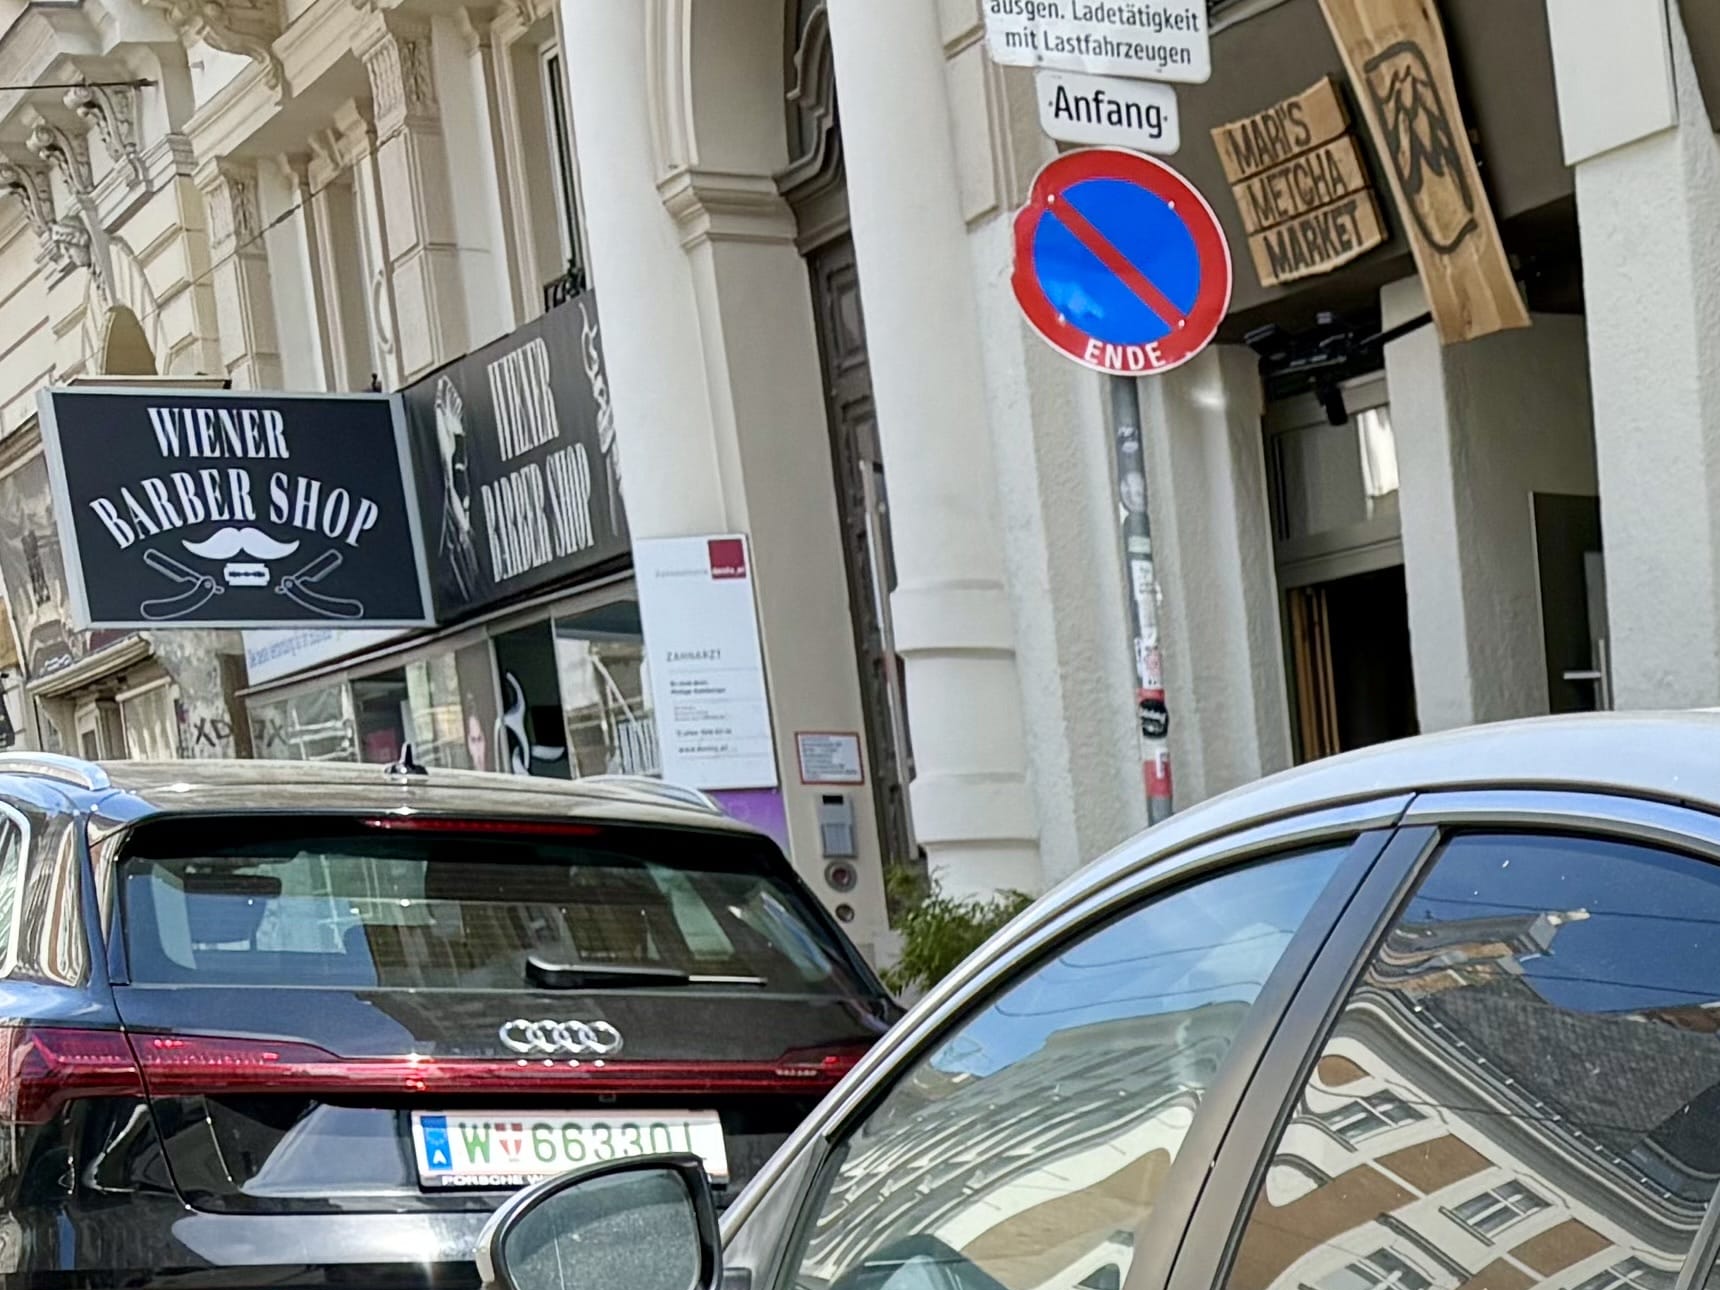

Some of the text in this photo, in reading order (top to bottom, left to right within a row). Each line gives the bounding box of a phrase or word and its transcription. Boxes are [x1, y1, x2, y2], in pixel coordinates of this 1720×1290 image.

[991, 0, 1200, 33] ausgen. Ladetätigkeit
[1005, 27, 1192, 67] mit Lastfahrzeugen
[1054, 85, 1163, 138] Anfang
[1263, 198, 1363, 280] MARKET
[1084, 337, 1166, 370] ENDE
[147, 407, 290, 459] WIENER
[89, 468, 379, 550] BARBER SHOP
[481, 442, 594, 583] BARBER SHOP
[433, 1149, 447, 1164] A
[458, 1122, 491, 1163] W
